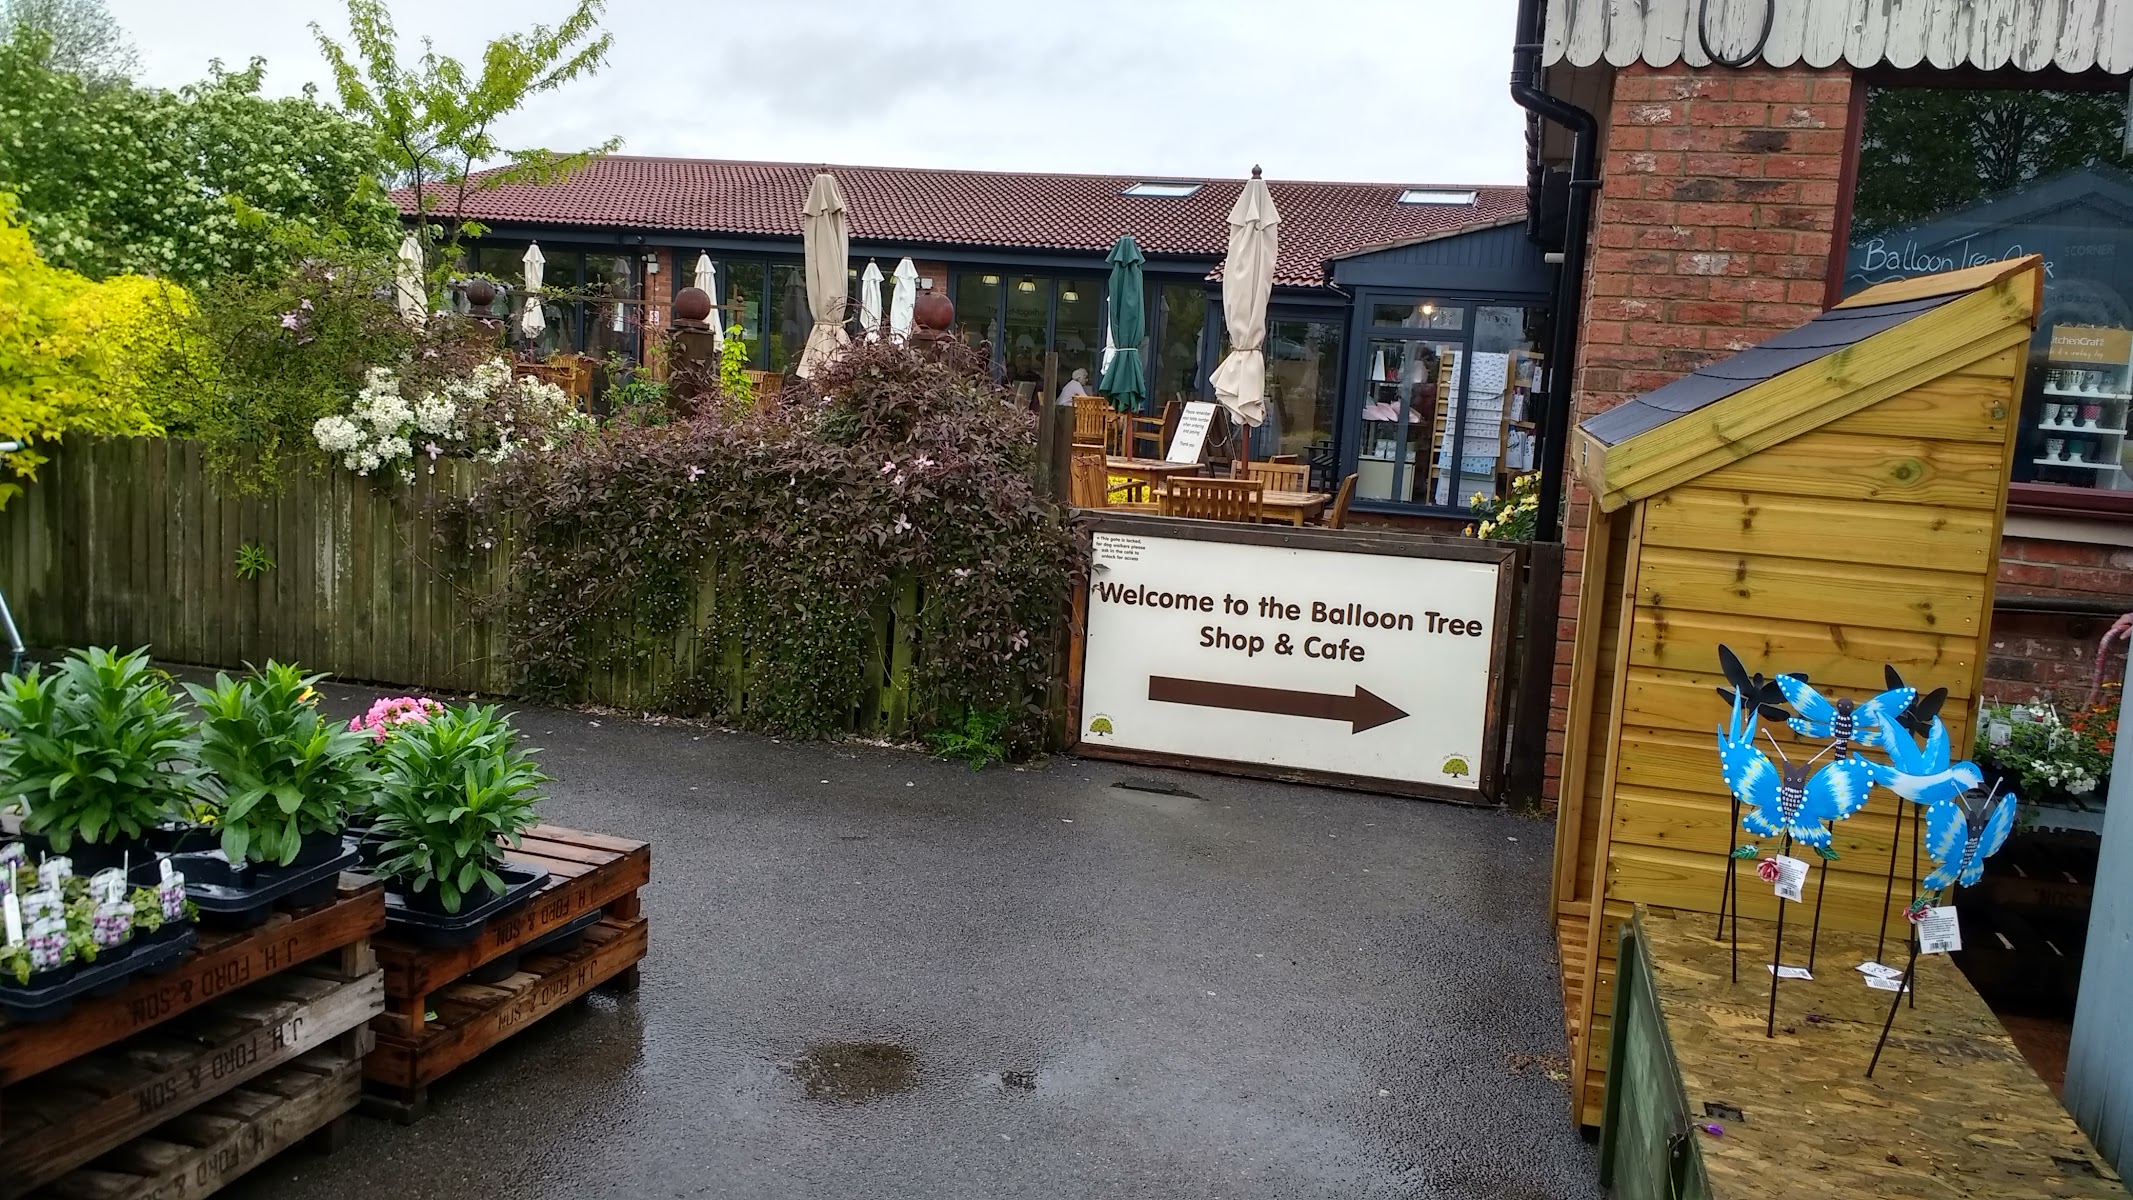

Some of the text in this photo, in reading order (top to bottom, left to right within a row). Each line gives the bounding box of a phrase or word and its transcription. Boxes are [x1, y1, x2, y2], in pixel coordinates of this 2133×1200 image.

[1860, 238, 1954, 272] Balloon
[1099, 582, 1484, 637] Welcome to the Balloon Tree
[1199, 626, 1366, 662] Shop & Cafe
[541, 895, 570, 924] FORD
[201, 955, 250, 997] FORD
[212, 1038, 258, 1080] FORD
